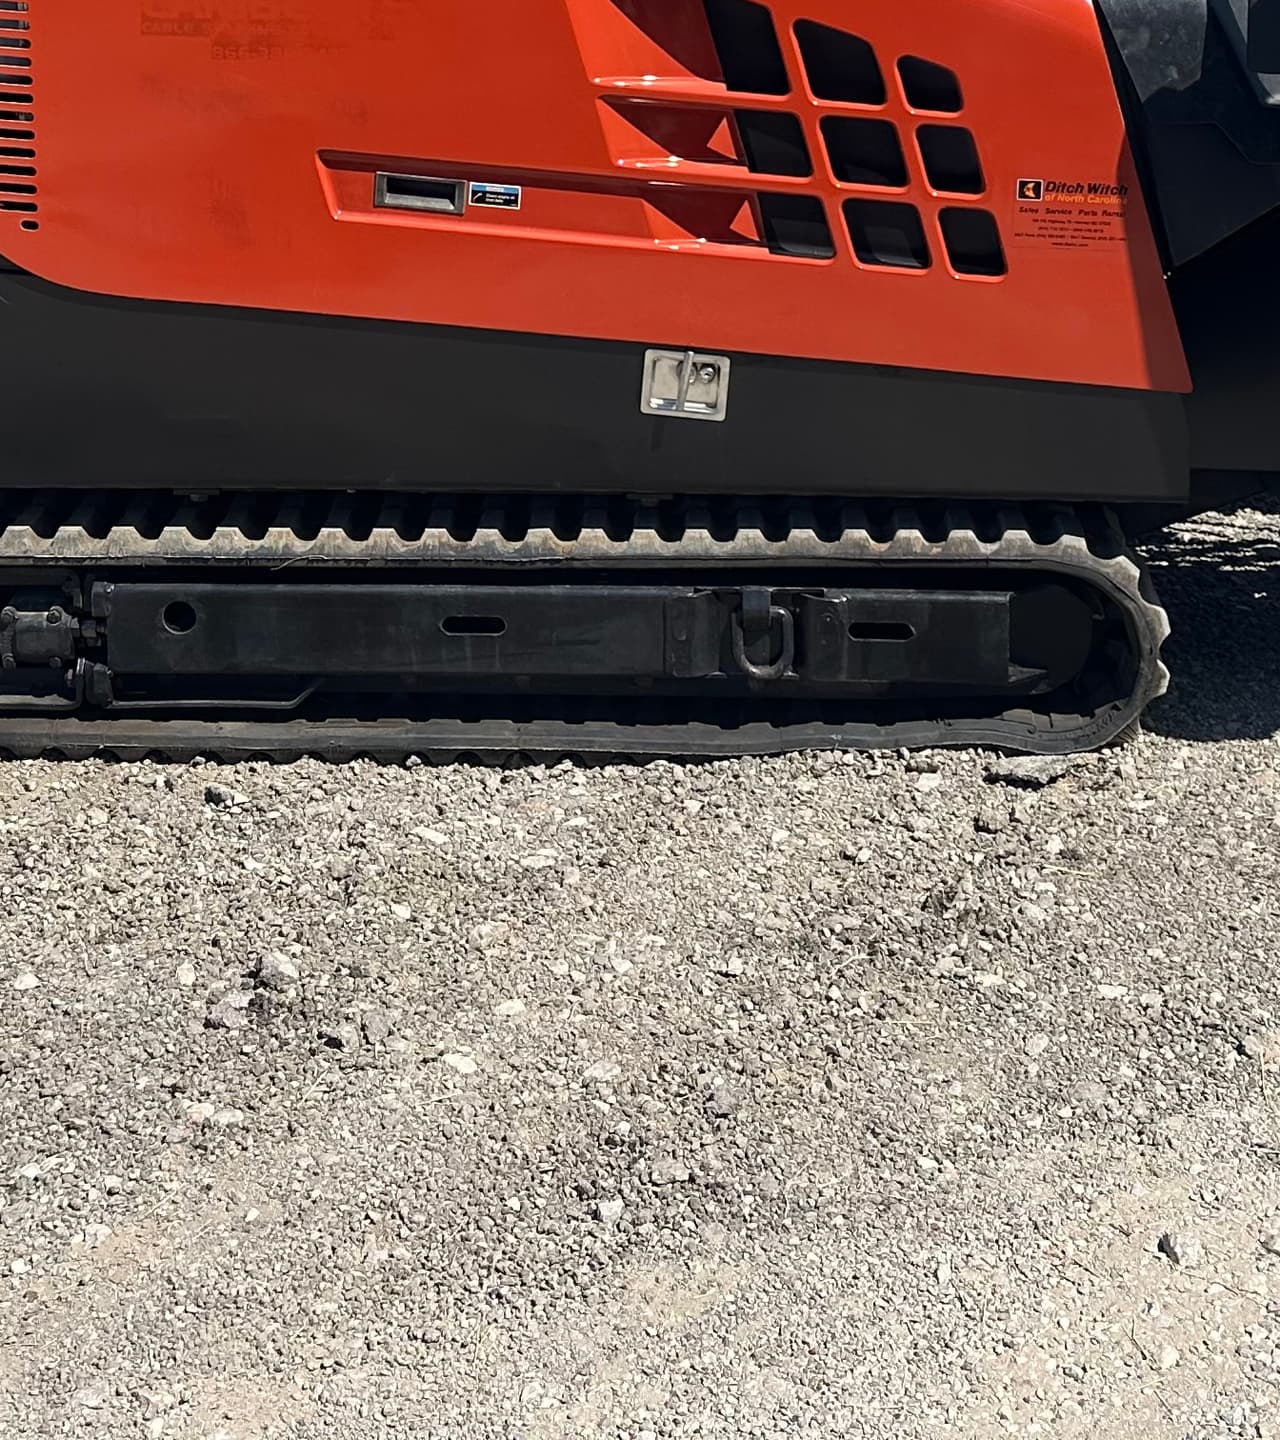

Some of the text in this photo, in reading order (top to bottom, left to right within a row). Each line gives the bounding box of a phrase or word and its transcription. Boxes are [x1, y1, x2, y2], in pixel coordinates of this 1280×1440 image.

[1044, 180, 1129, 196] Ditch Witch
[1044, 194, 1056, 202] of
[1057, 194, 1085, 203] North
